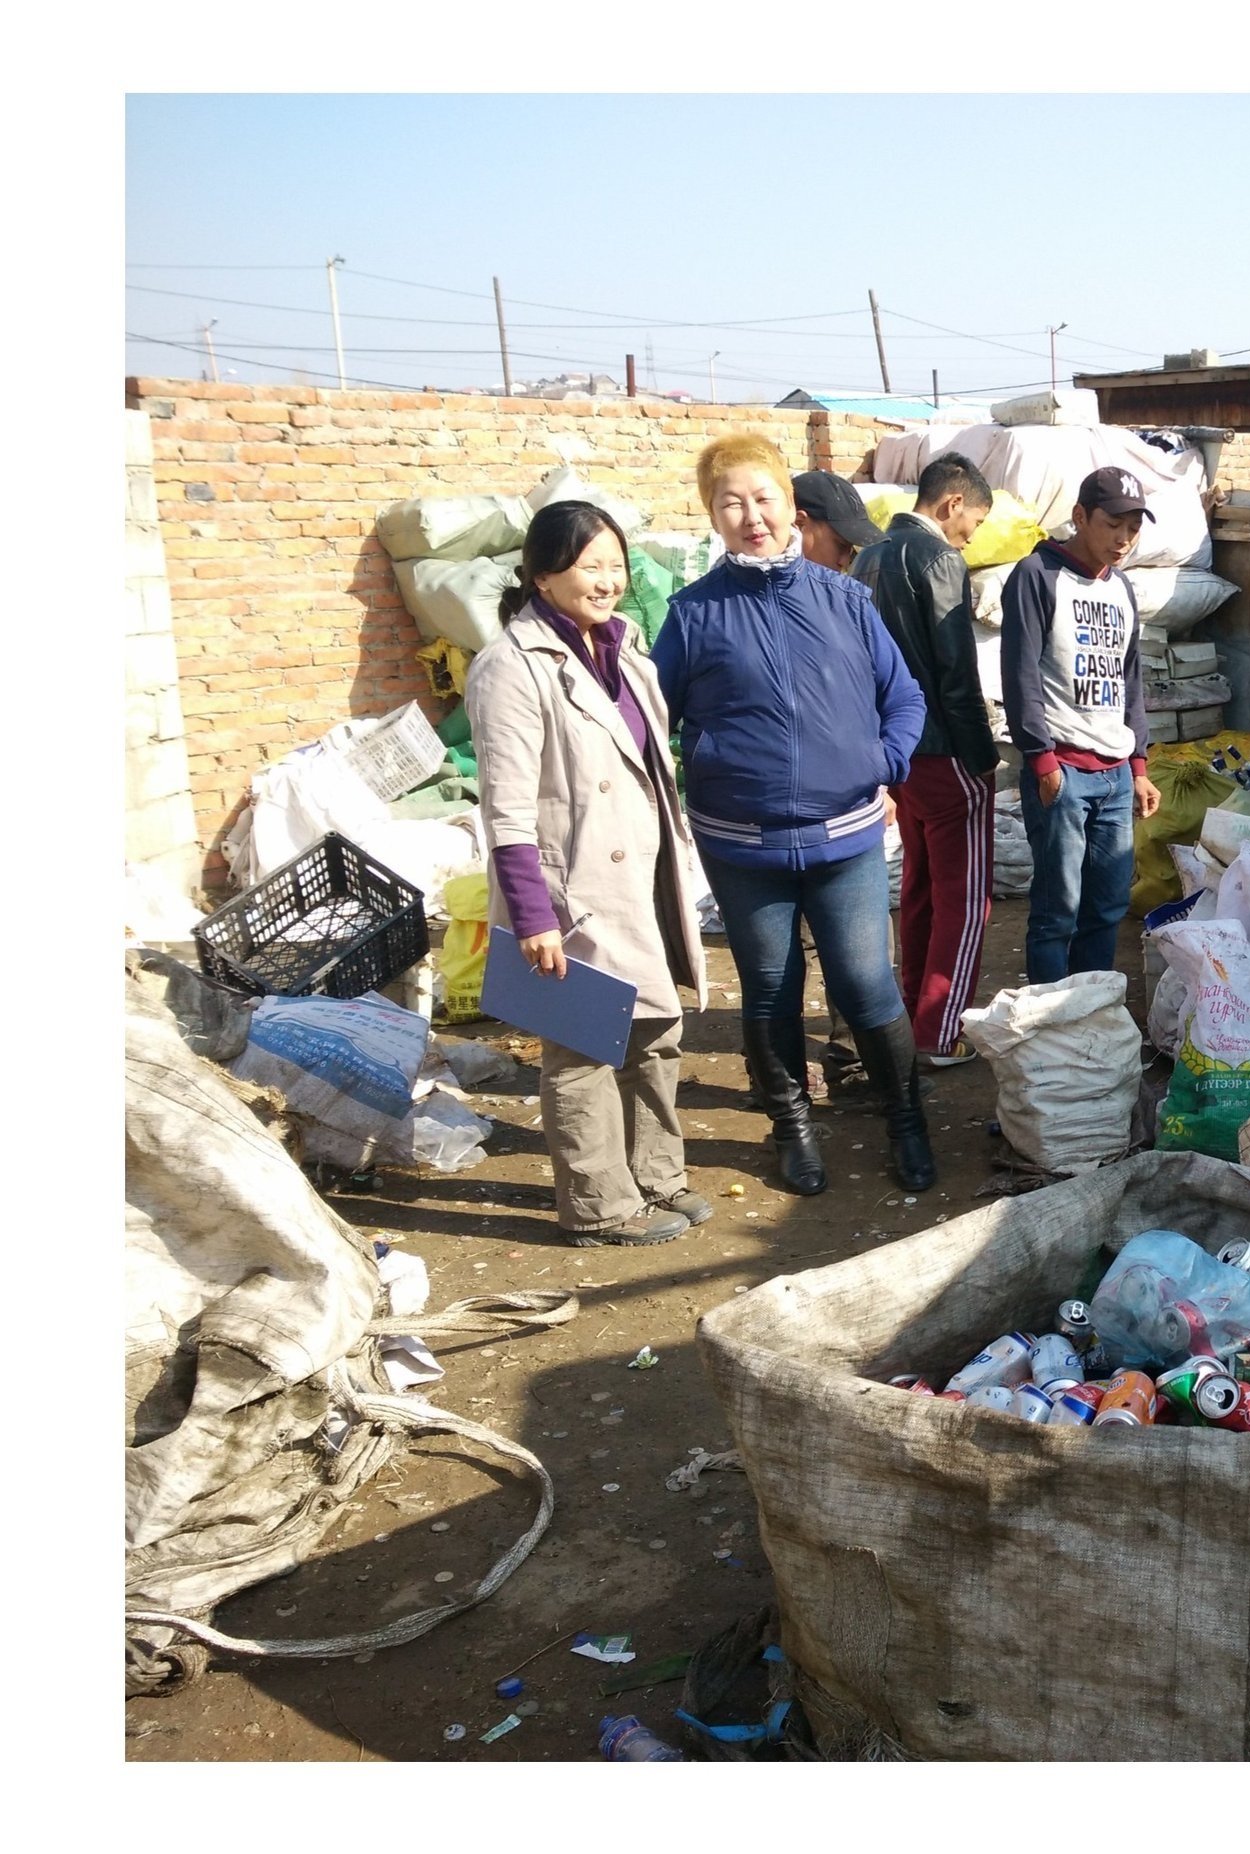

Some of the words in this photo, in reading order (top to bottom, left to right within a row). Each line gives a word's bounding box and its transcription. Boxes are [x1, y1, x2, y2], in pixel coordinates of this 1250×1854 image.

[1120, 474, 1140, 499] NY
[1073, 599, 1125, 630] COMEON
[1090, 627, 1125, 649] DREAM
[1073, 678, 1121, 707] WEAR
